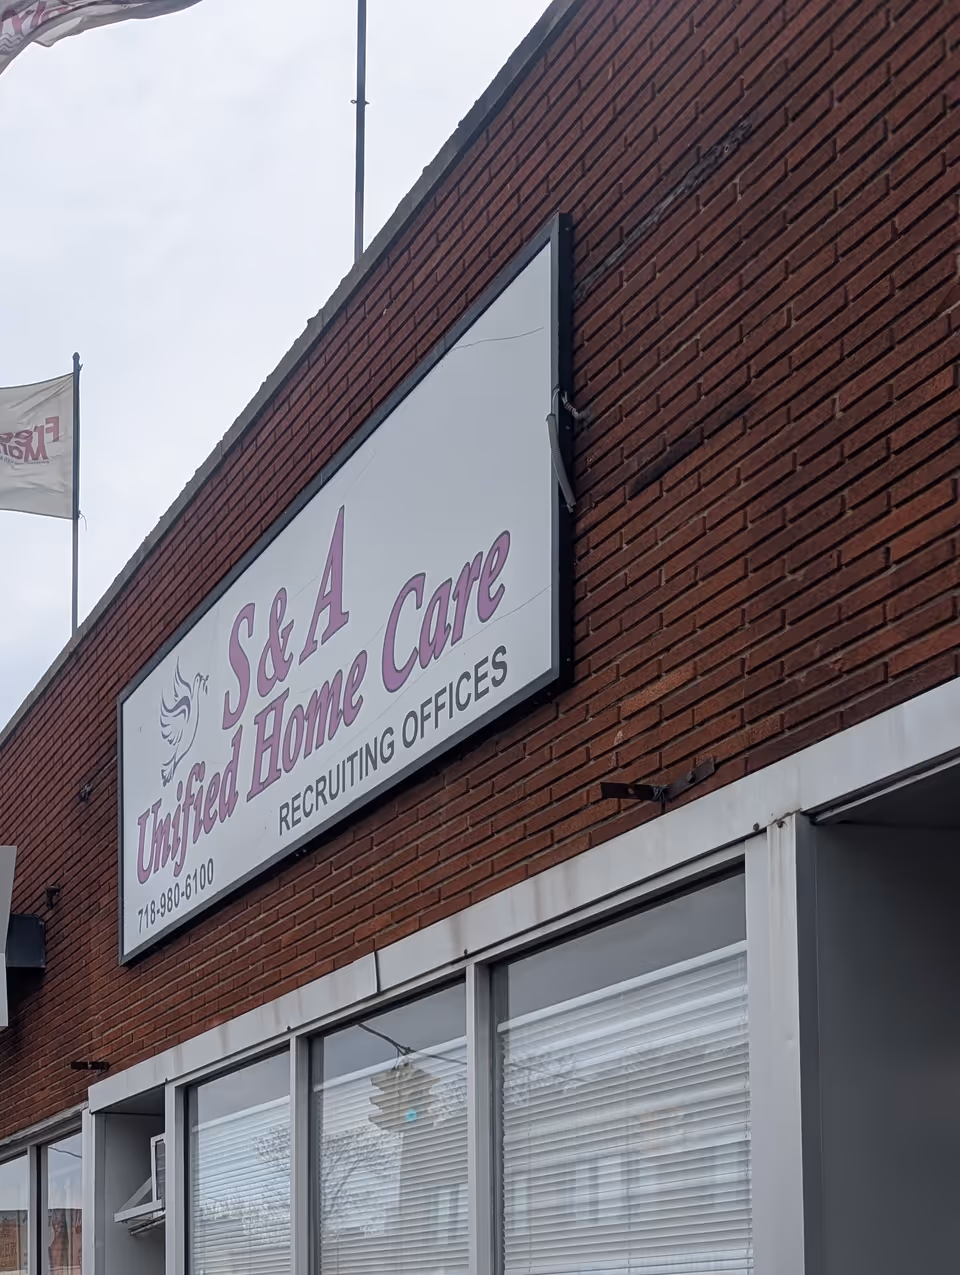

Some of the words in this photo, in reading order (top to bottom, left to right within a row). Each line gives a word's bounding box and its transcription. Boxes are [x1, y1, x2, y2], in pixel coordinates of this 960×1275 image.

[136, 724, 243, 885] Unified
[247, 649, 369, 804] Home
[381, 530, 512, 694] Care
[278, 727, 395, 836] RECRUITING
[401, 645, 509, 749] OFFICES
[137, 857, 215, 935] 718-980-6100
